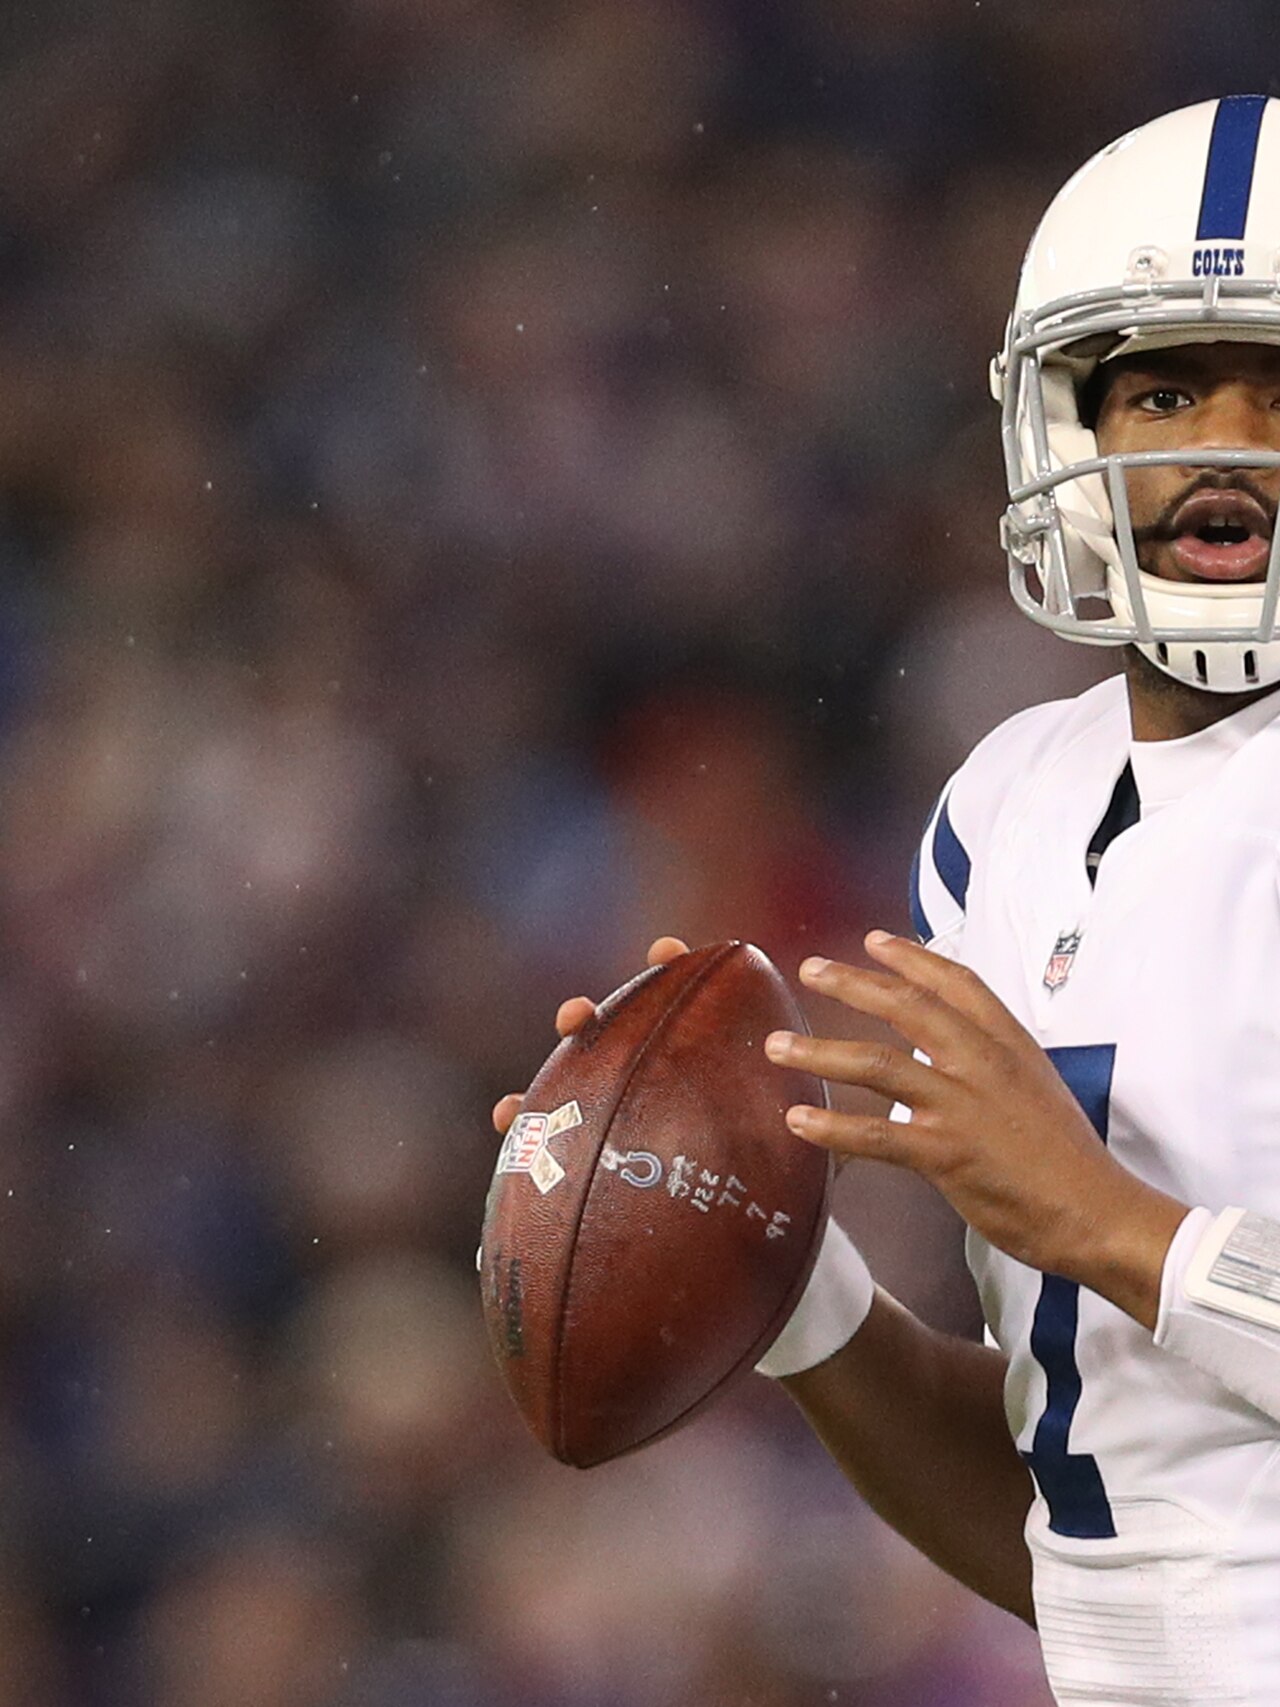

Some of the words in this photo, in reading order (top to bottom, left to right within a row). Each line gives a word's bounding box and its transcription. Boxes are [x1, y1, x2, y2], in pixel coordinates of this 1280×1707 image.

[1193, 249, 1244, 277] COLTS
[518, 1121, 544, 1163] NFL
[746, 1201, 767, 1220] 7
